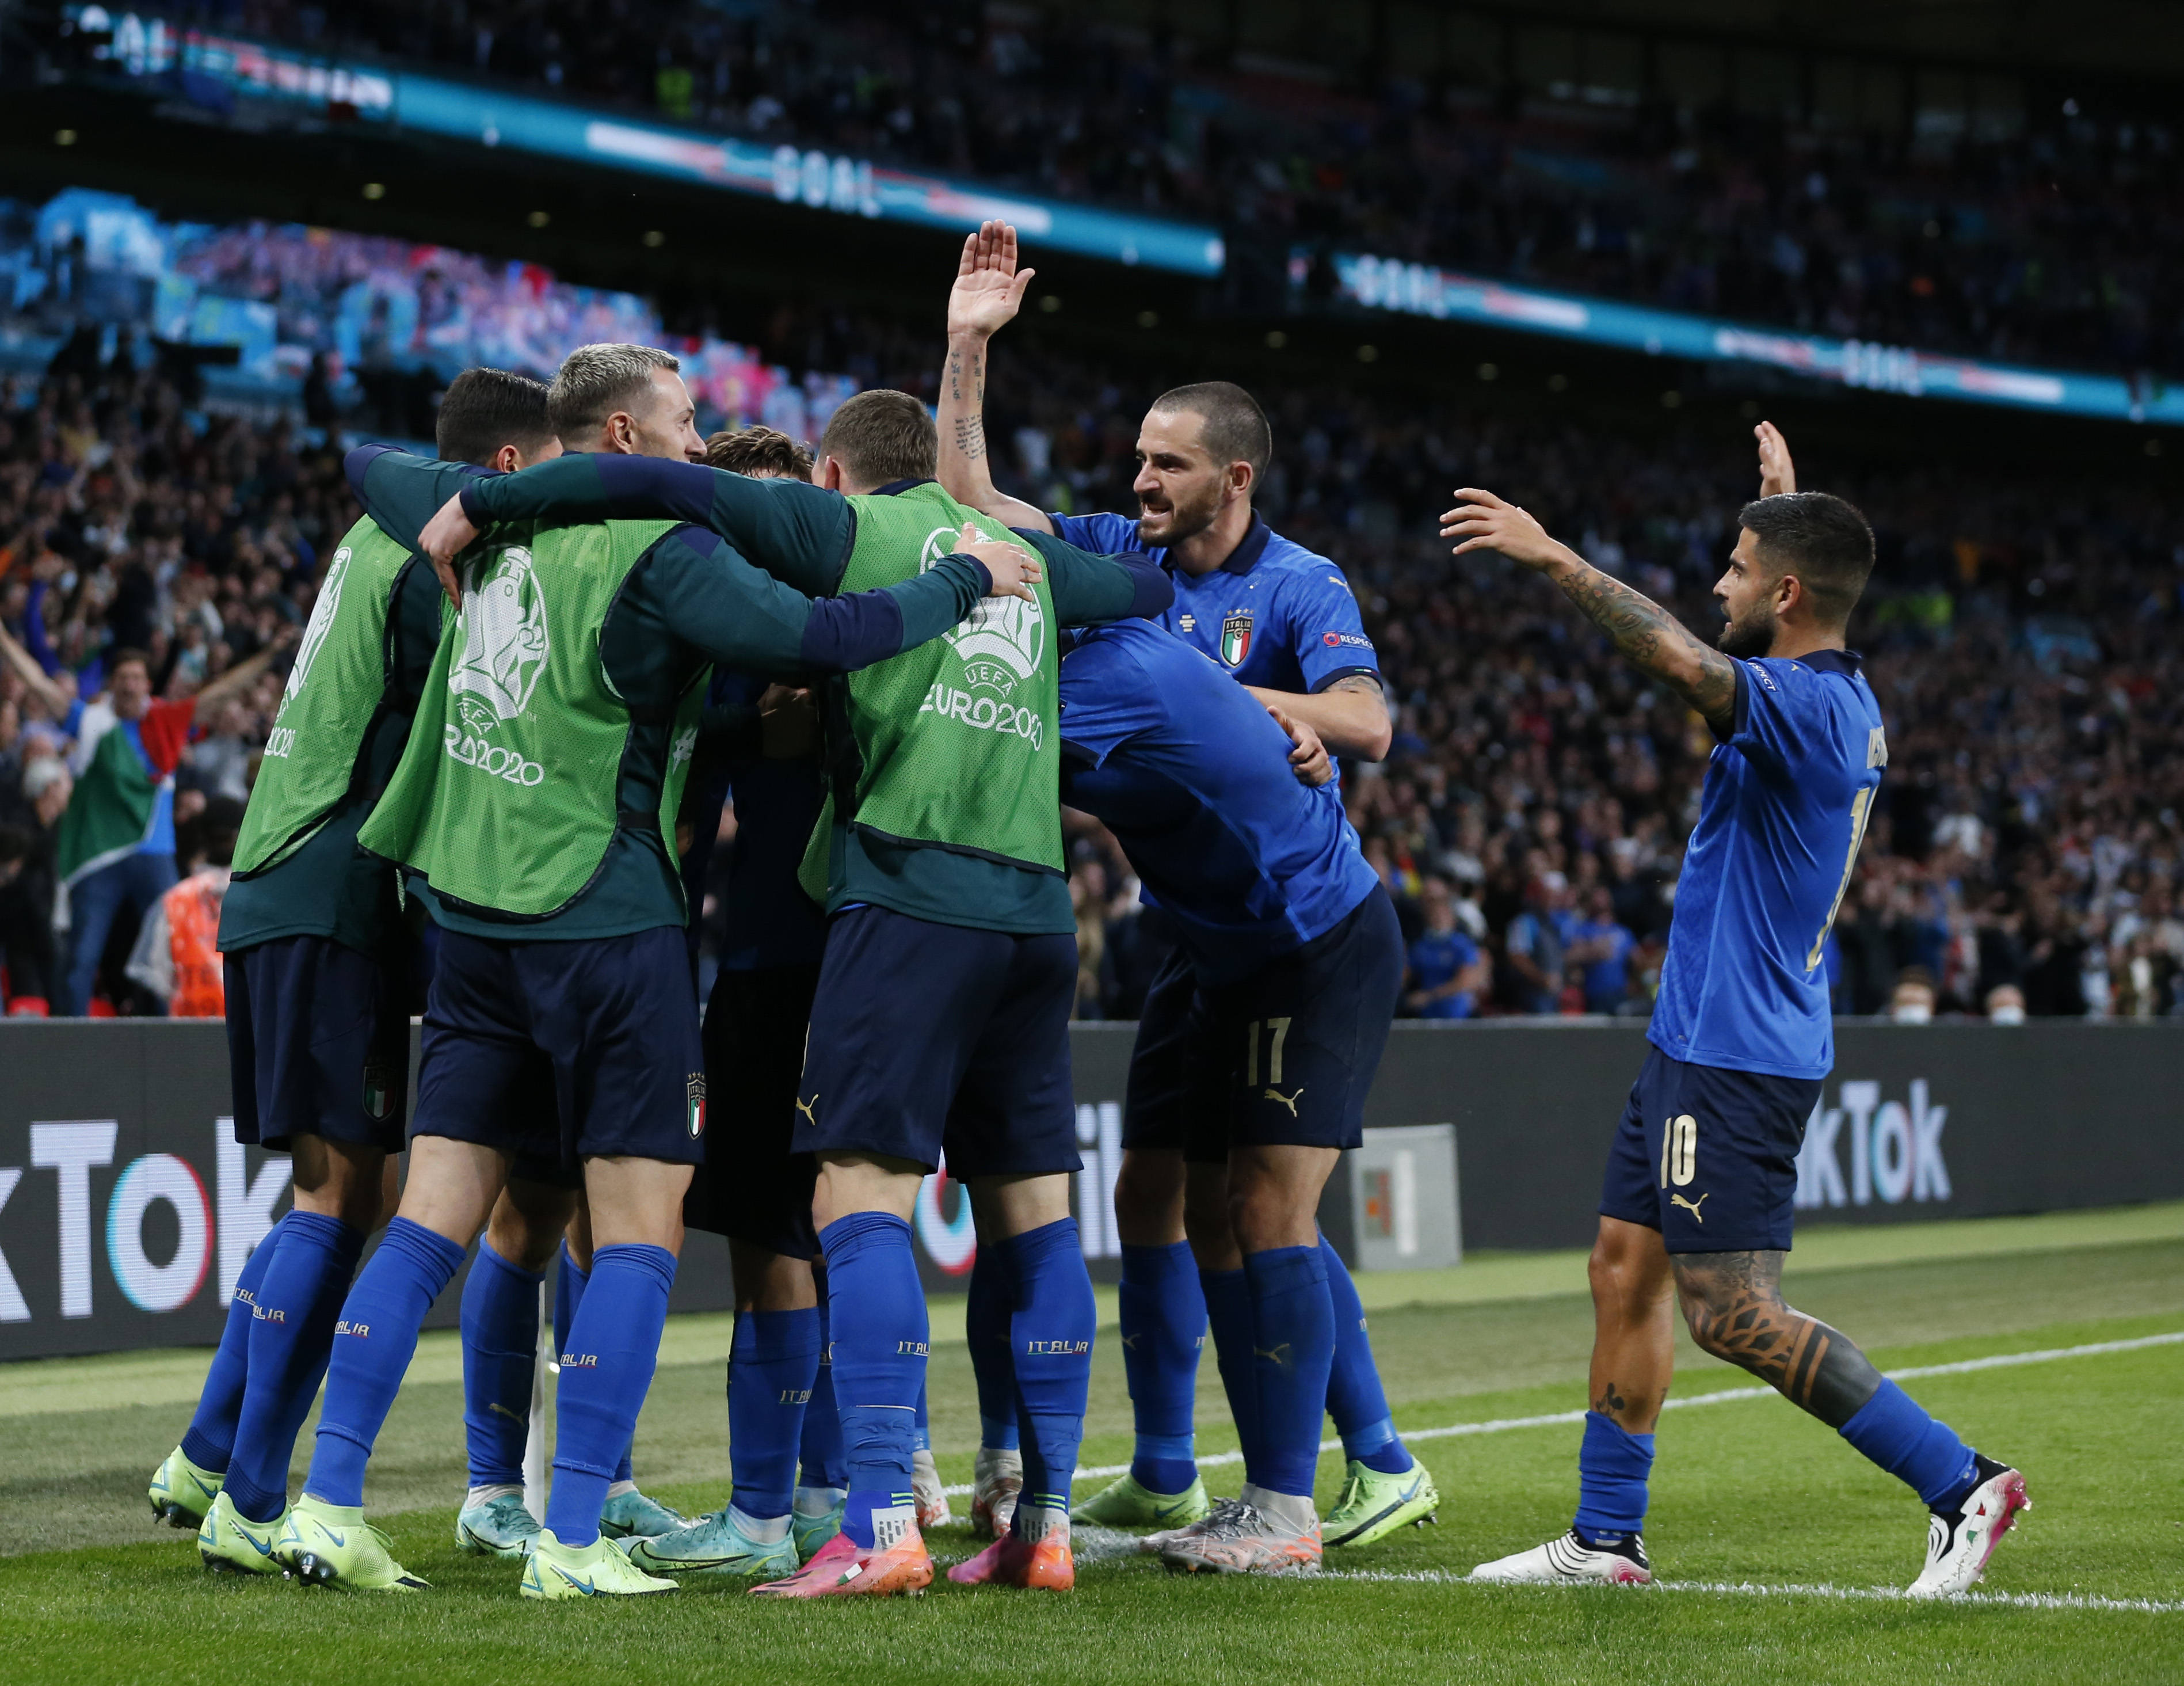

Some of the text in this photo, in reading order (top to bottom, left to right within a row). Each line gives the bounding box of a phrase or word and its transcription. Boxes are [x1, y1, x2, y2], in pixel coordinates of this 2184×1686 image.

[1226, 621, 1251, 629] ITALIA
[966, 667, 1012, 695] UEFA
[445, 724, 544, 786] RO2020
[1247, 1017, 1291, 1086] 17
[1660, 1114, 1697, 1189] 10
[1794, 1079, 1951, 1207] kTok
[898, 1341, 931, 1353] ITAL
[1028, 1340, 1089, 1353] ITALIA
